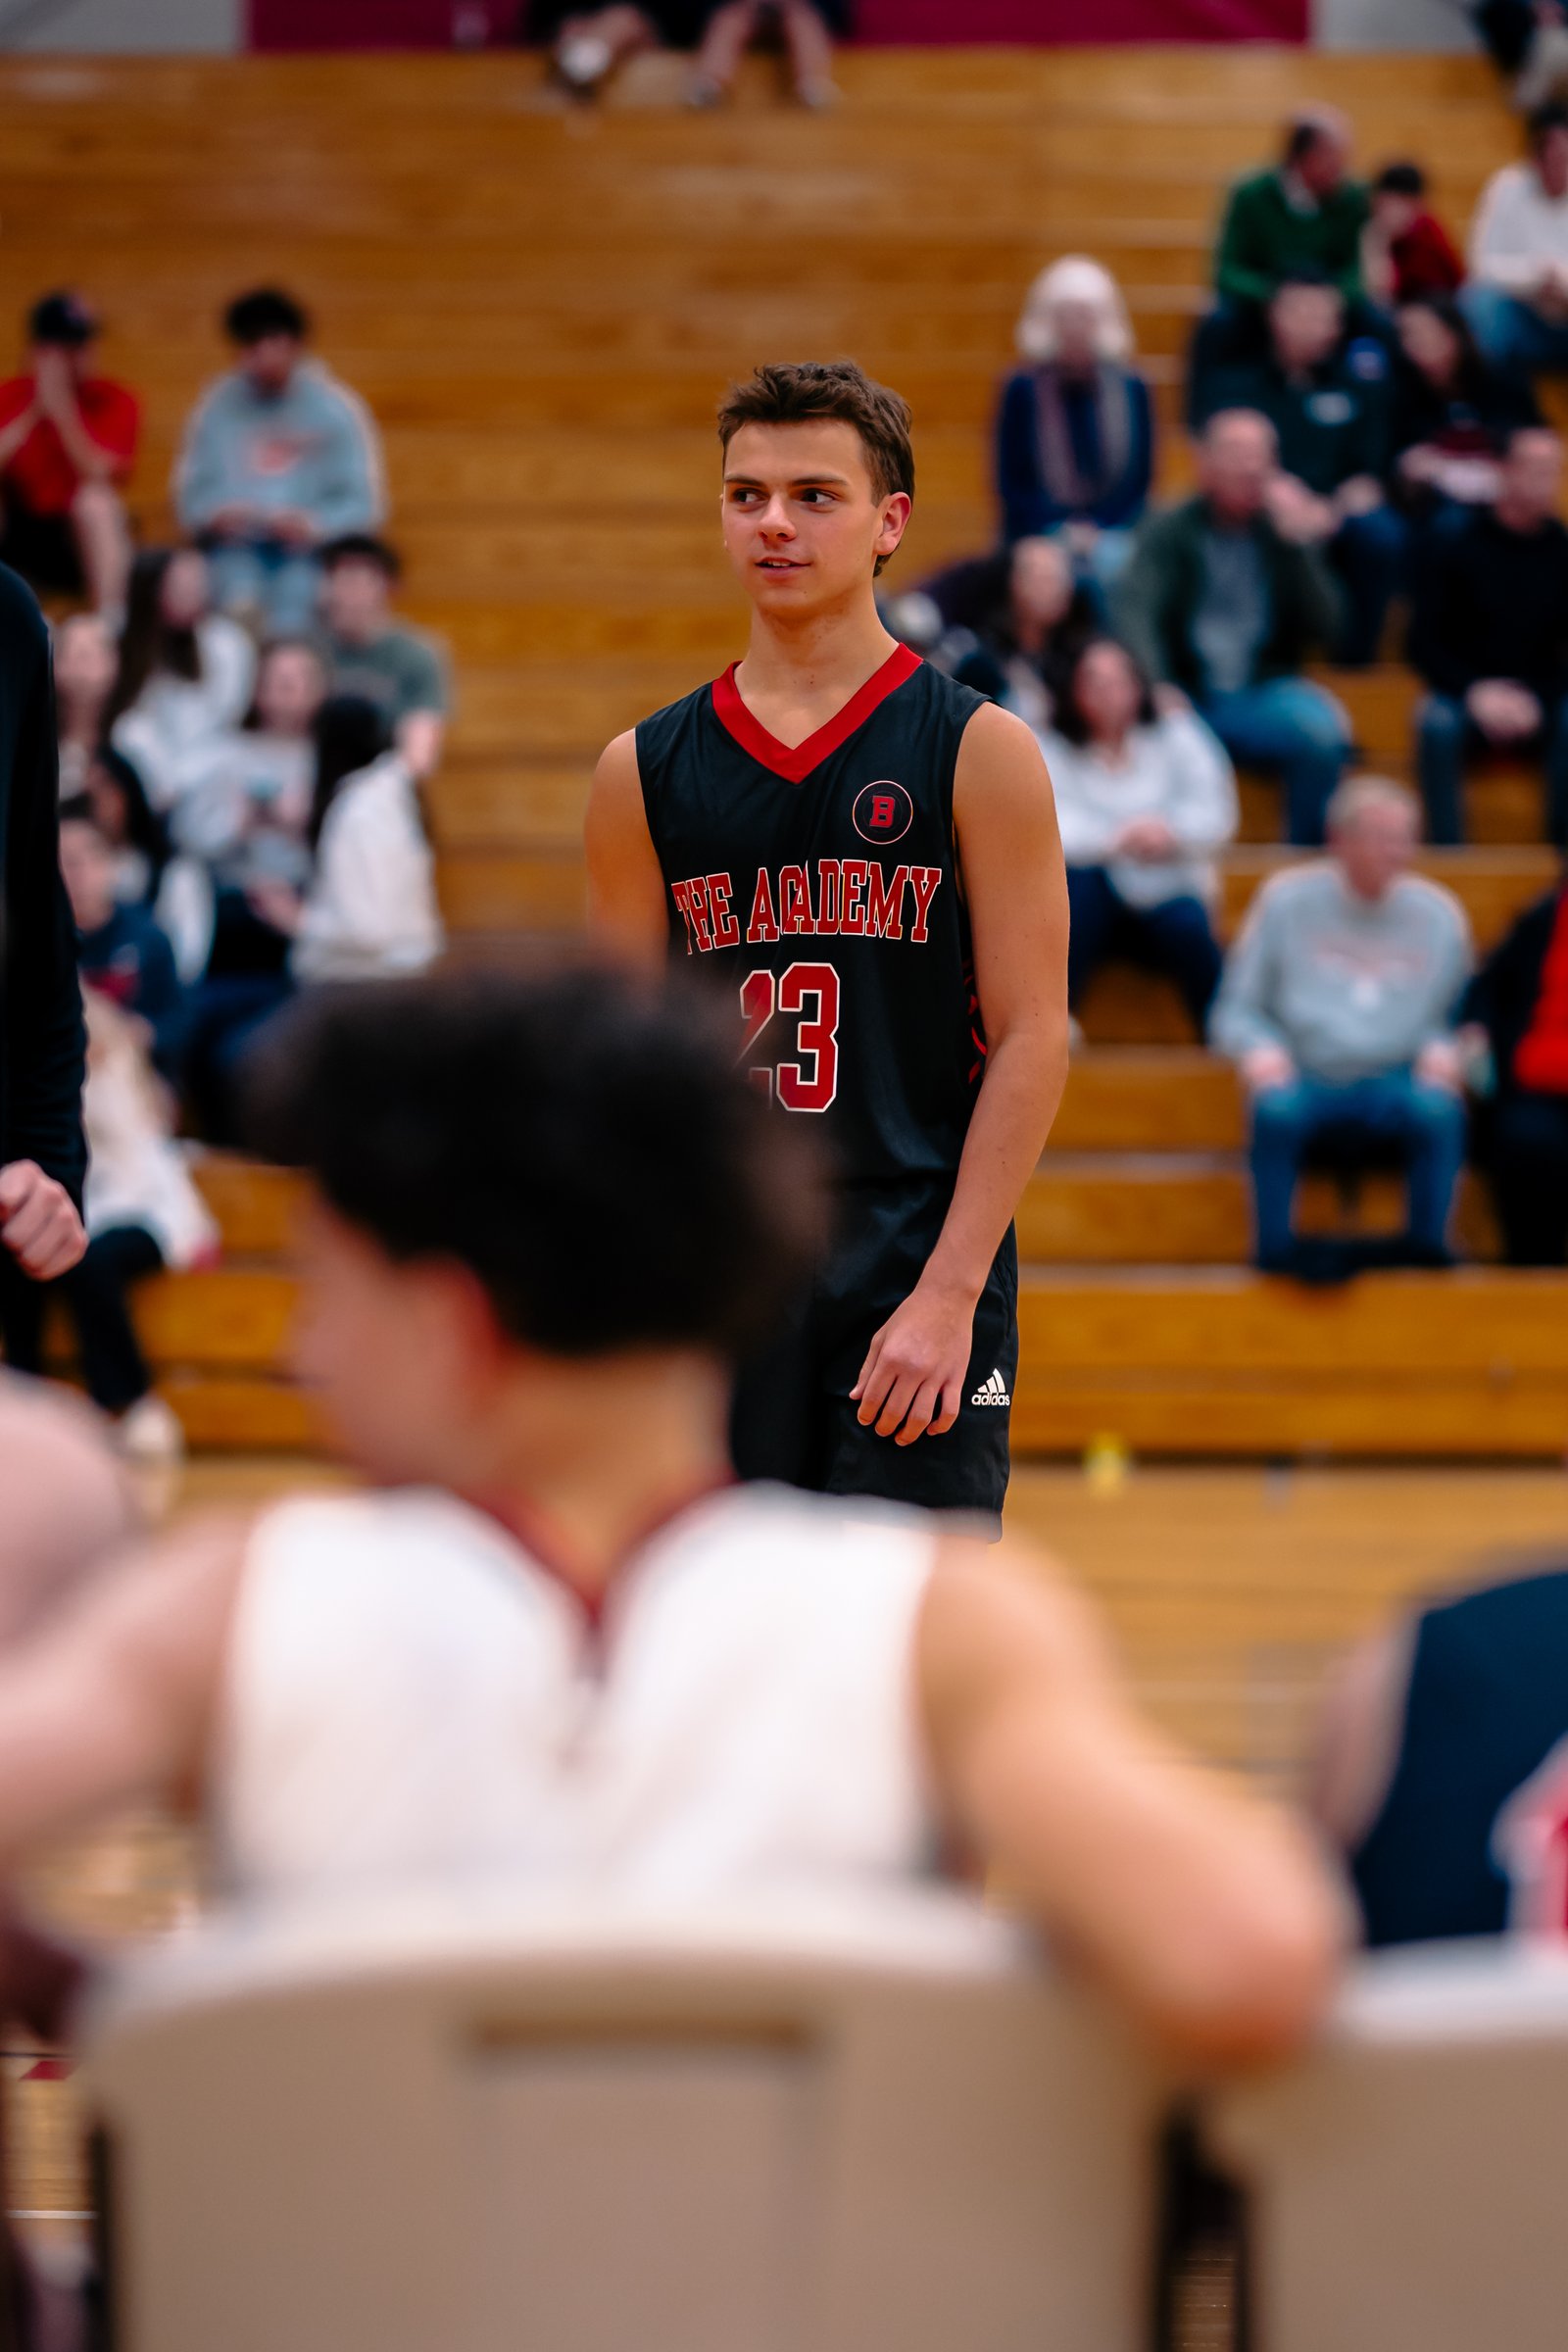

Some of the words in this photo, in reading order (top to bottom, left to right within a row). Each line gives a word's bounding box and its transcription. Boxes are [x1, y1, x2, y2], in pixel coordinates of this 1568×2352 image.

[869, 795, 896, 828] B
[671, 872, 740, 956] THE
[746, 858, 943, 944] ACADEMY
[737, 961, 841, 1113] 23
[971, 1392, 1010, 1406] adidas
